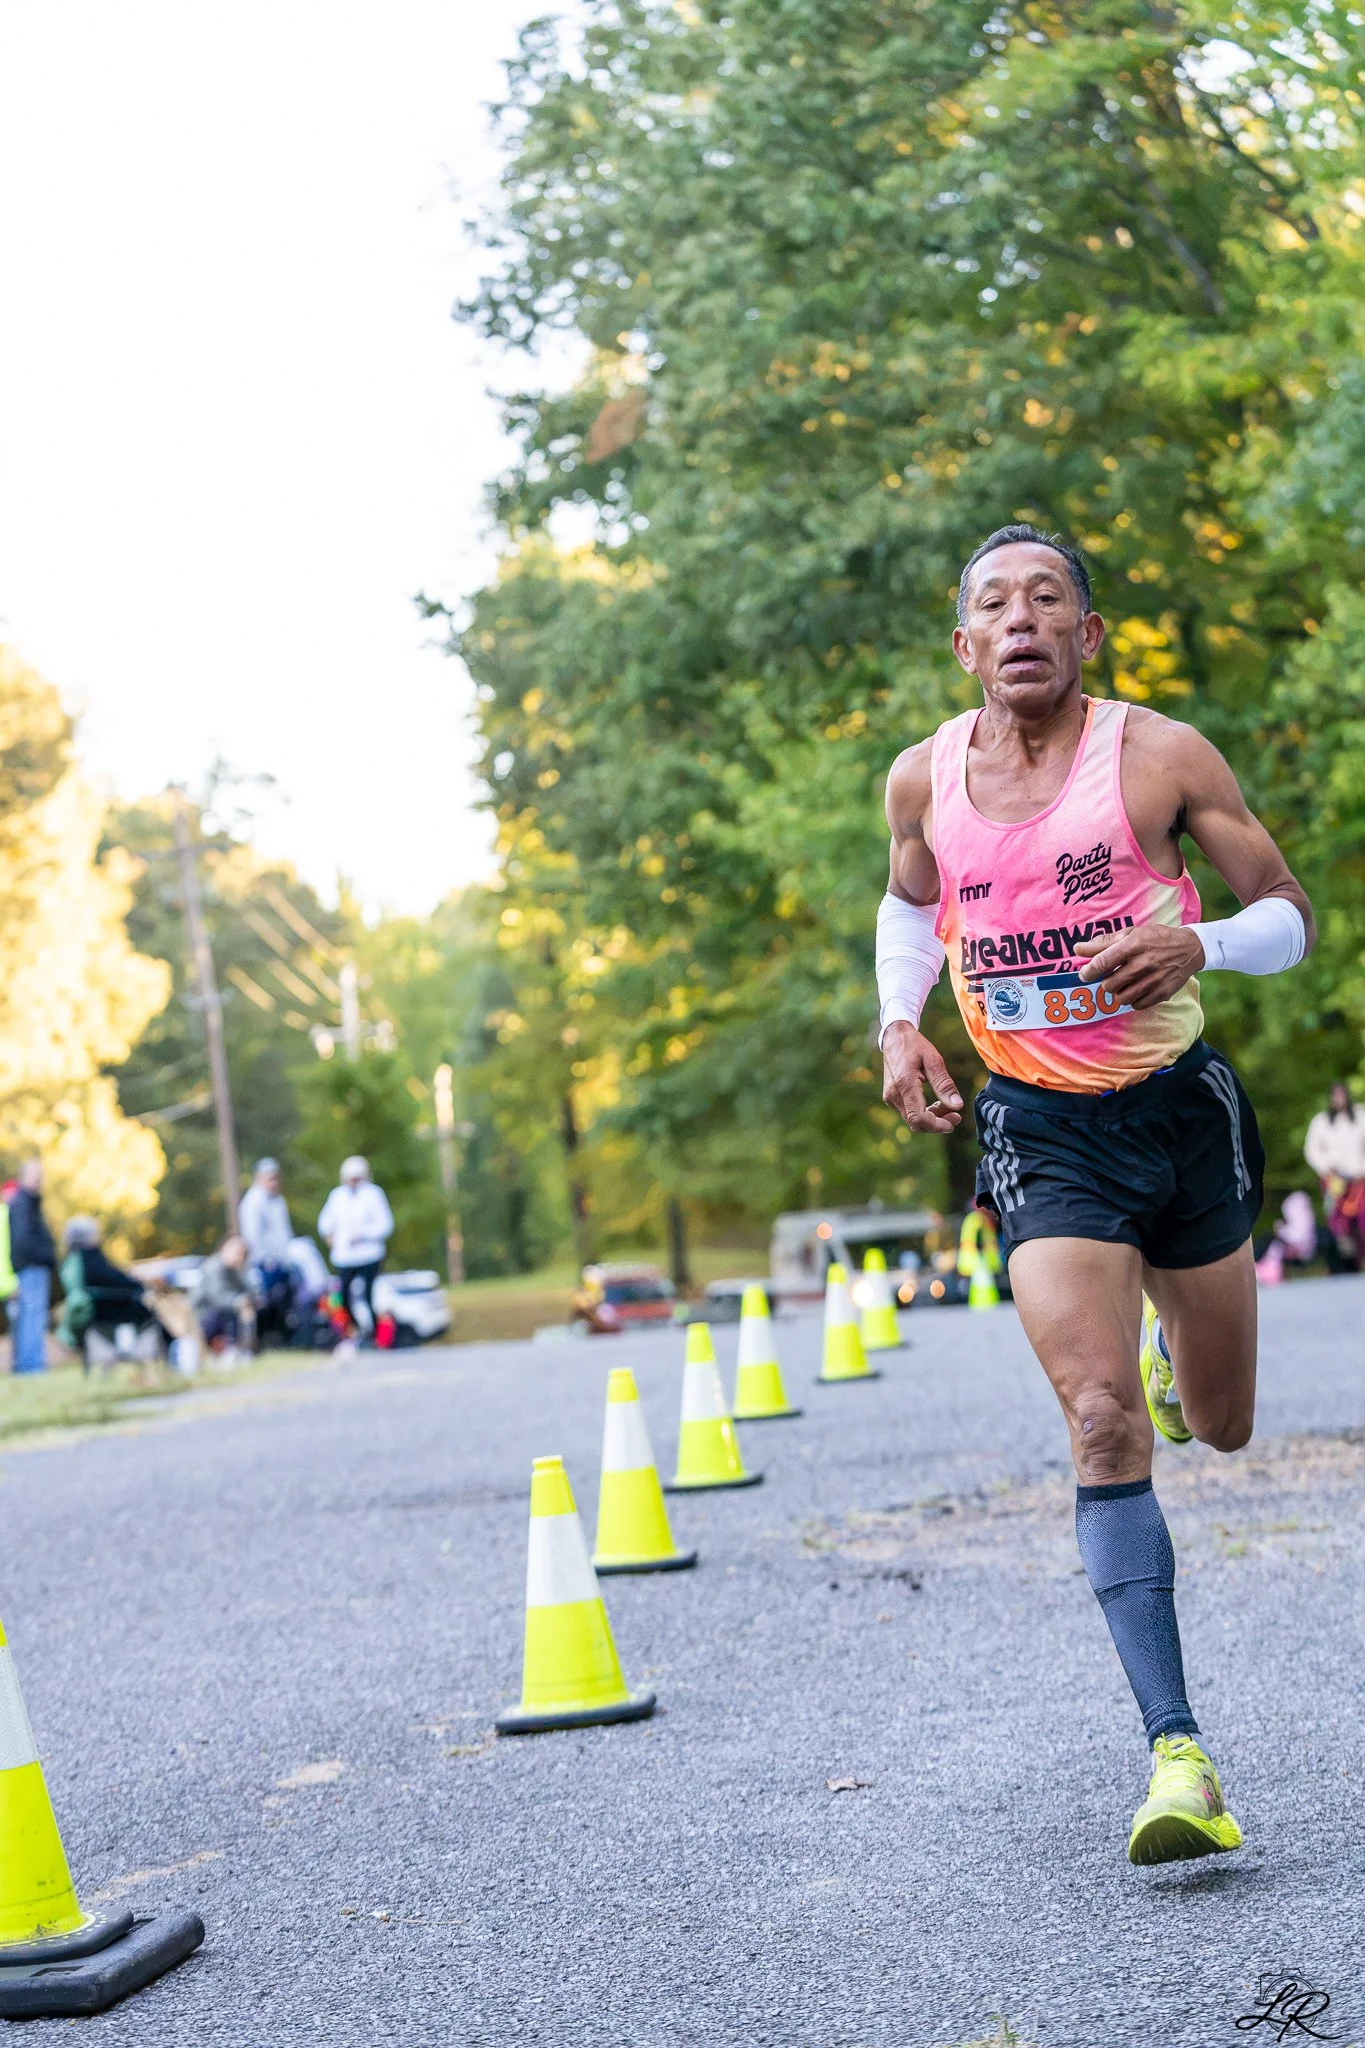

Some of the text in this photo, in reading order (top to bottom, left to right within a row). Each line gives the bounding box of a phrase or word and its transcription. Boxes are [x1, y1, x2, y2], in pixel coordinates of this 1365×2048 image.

[1056, 842, 1112, 885] Party
[959, 882, 991, 903] rnnr
[1063, 868, 1113, 905] Pace
[1044, 985, 1121, 1024] 830
